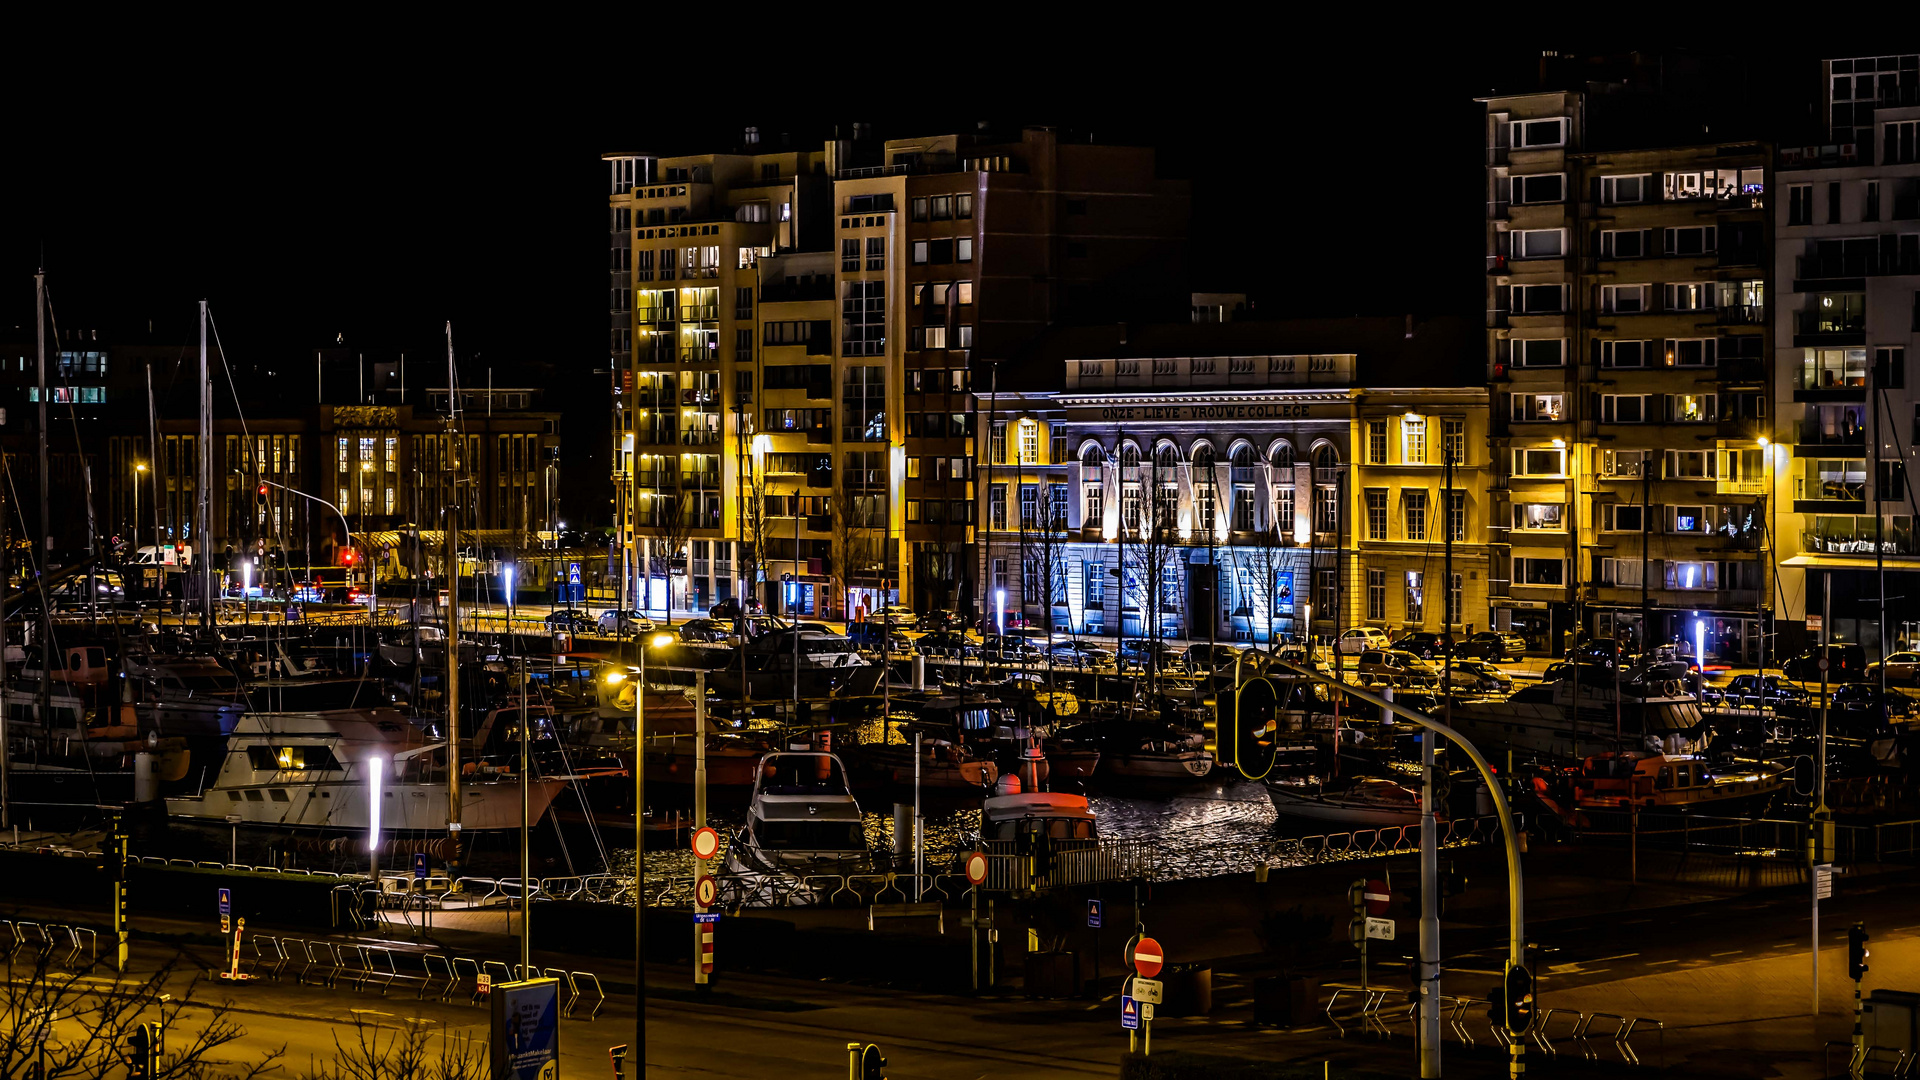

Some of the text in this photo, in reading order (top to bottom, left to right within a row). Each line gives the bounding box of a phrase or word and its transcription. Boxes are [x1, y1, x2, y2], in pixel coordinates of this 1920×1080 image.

[1102, 408, 1134, 418] ONZE
[1144, 407, 1180, 418] LIEVE
[1191, 406, 1246, 418] VROUWE
[1248, 405, 1310, 418] COLLEGE
